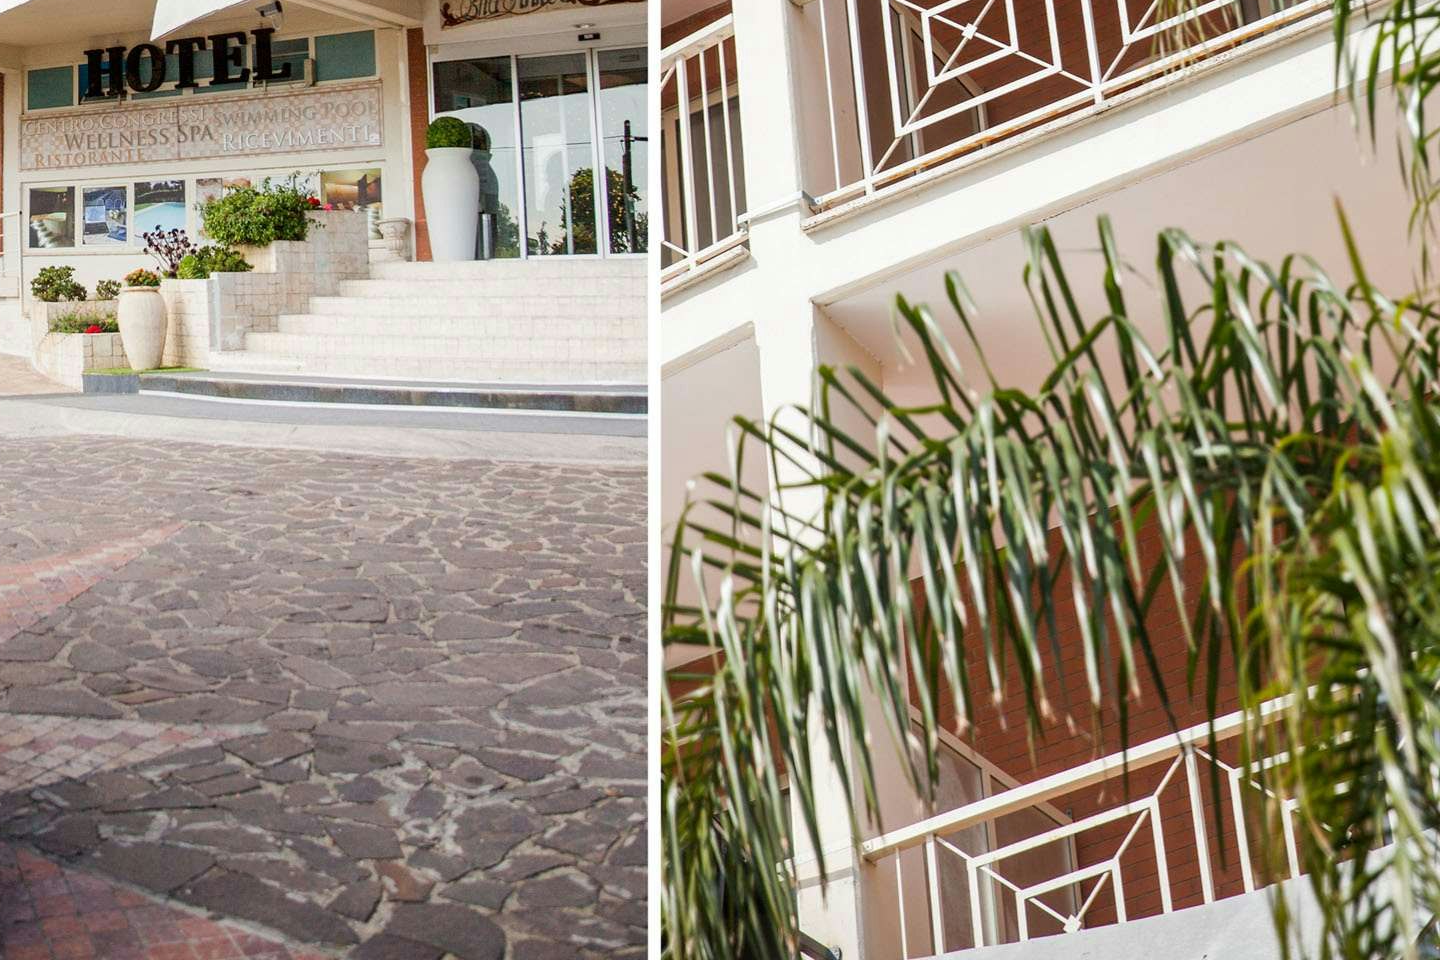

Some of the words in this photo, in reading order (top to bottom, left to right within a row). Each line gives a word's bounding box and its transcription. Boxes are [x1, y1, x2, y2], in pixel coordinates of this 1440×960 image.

[84, 28, 291, 97] HOTEL
[24, 118, 95, 136] CENTRO
[100, 108, 207, 130] CONGRESSI
[213, 106, 317, 128] SWIMMING
[320, 100, 378, 119] POOL
[64, 128, 169, 152] WELLNESS
[177, 124, 213, 143] SPA
[223, 124, 371, 151] RICEVIMENTI
[35, 148, 145, 169] RISTORANTE
